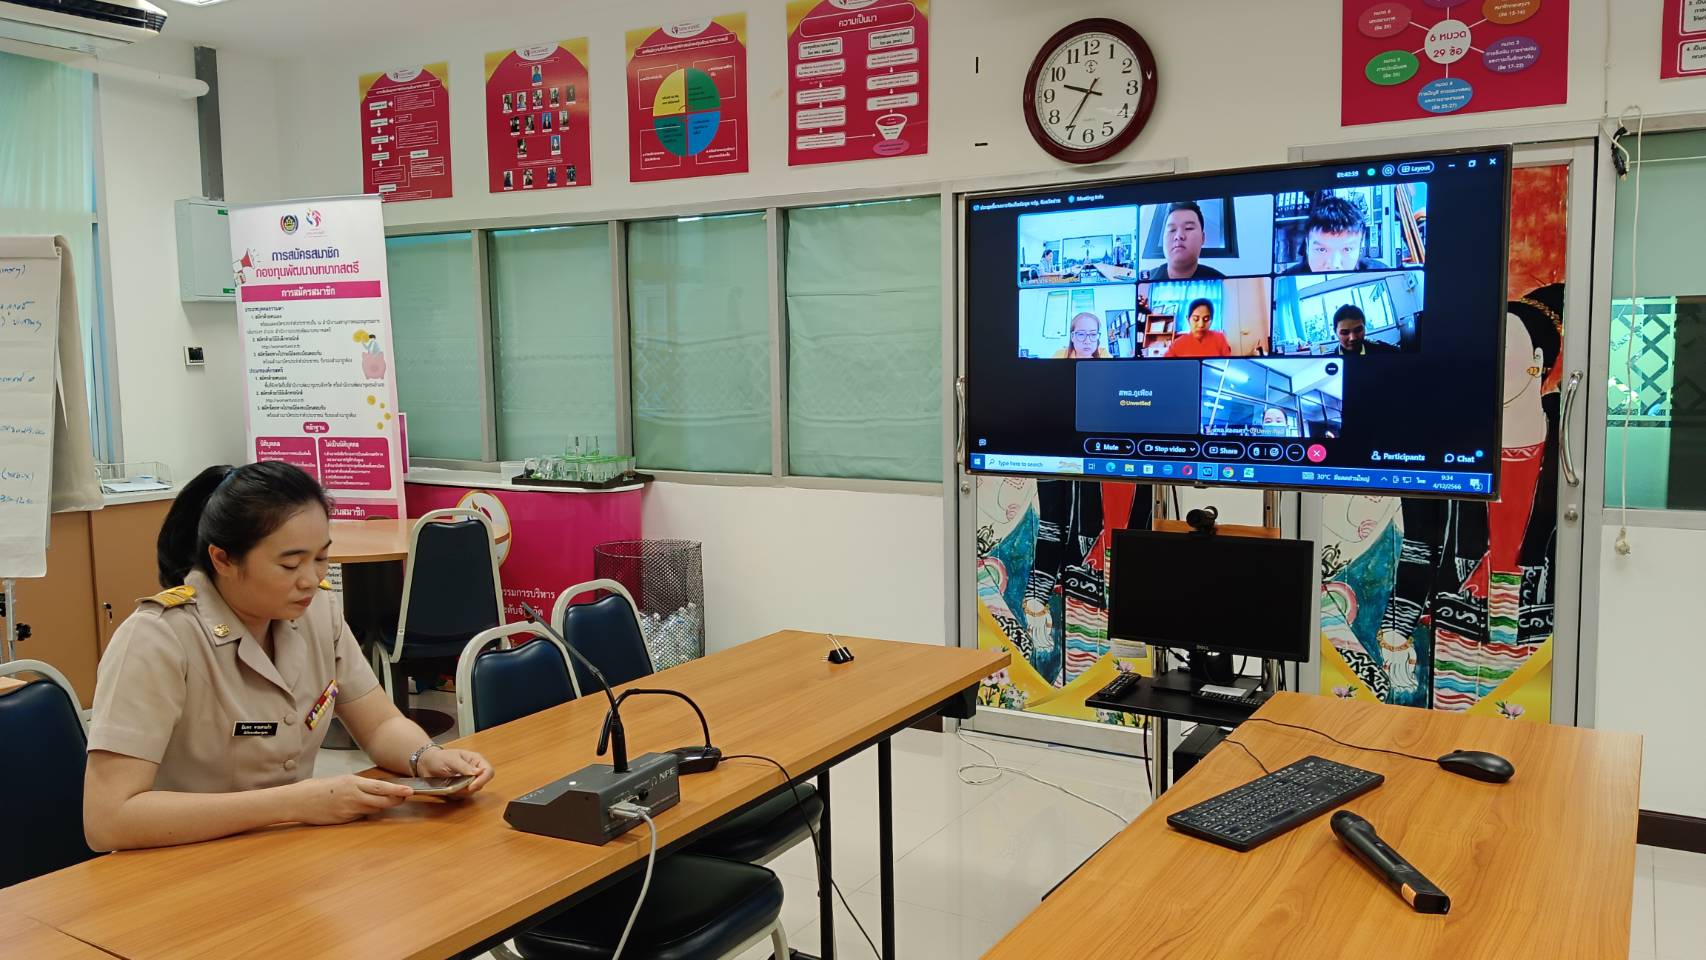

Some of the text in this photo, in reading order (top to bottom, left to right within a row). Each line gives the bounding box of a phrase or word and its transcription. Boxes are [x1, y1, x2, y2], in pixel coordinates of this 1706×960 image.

[838, 13, 878, 28] ความเป็นมา
[1430, 30, 1467, 42] 6 หมวด
[1084, 40, 1100, 56] 12
[1109, 44, 1114, 59] 1
[1433, 45, 1463, 58] 29 ข้อ
[1066, 48, 1080, 64] 11
[1121, 58, 1132, 73] 2
[1051, 66, 1066, 82] 10
[1126, 80, 1139, 95] 3
[1043, 88, 1055, 103] 9
[1048, 109, 1060, 124] 8
[1117, 102, 1129, 118] 4
[1065, 124, 1076, 140] 7
[1082, 128, 1095, 143] 6
[1102, 121, 1114, 136] 5
[1411, 164, 1431, 173] Layout
[272, 247, 339, 262] การสมัครสมาชิก
[256, 261, 360, 280] กองทุนพัฒนาบทบาทสตรี
[281, 286, 336, 298] การสมัครสมาชิก
[1103, 443, 1119, 451] Mute
[1154, 445, 1167, 453] Stop
[1383, 452, 1426, 462] Participants
[1457, 455, 1475, 463] Chat
[1316, 473, 1331, 481] 30°C
[659, 766, 677, 780] NPE
